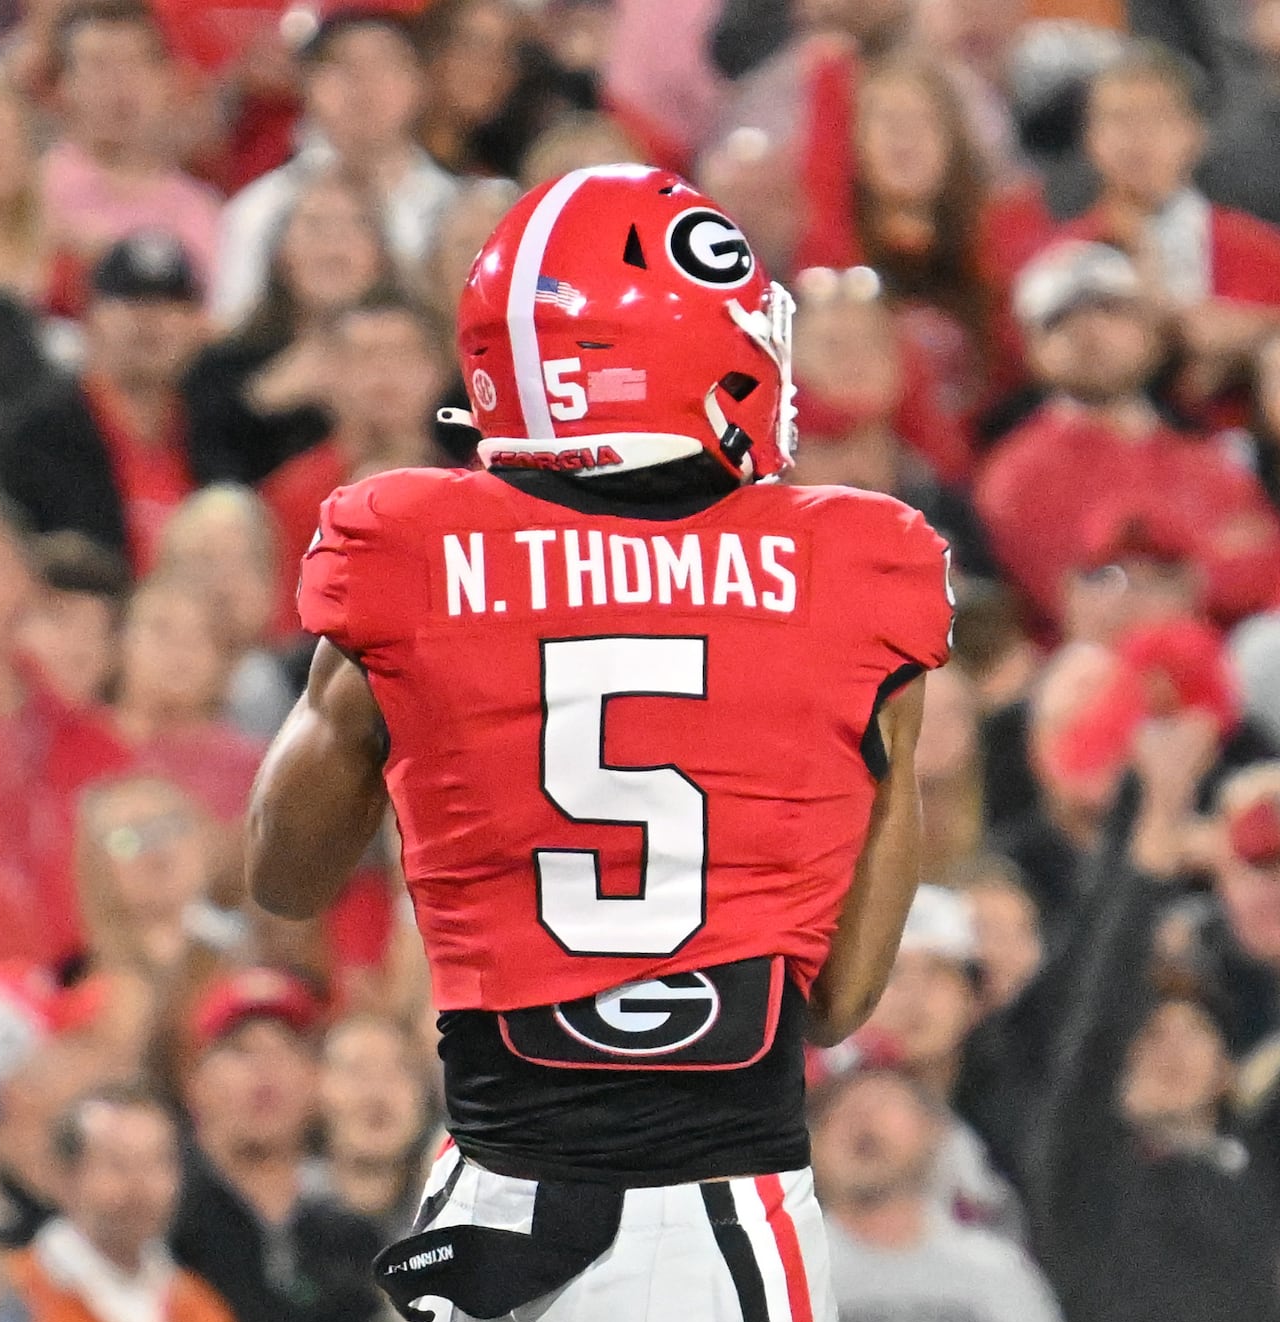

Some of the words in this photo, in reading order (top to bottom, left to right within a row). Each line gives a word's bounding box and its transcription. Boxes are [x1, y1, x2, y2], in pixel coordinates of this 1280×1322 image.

[666, 207, 755, 289] G
[543, 357, 588, 421] 5
[514, 529, 797, 613] THOMAS
[533, 634, 709, 958] 5
